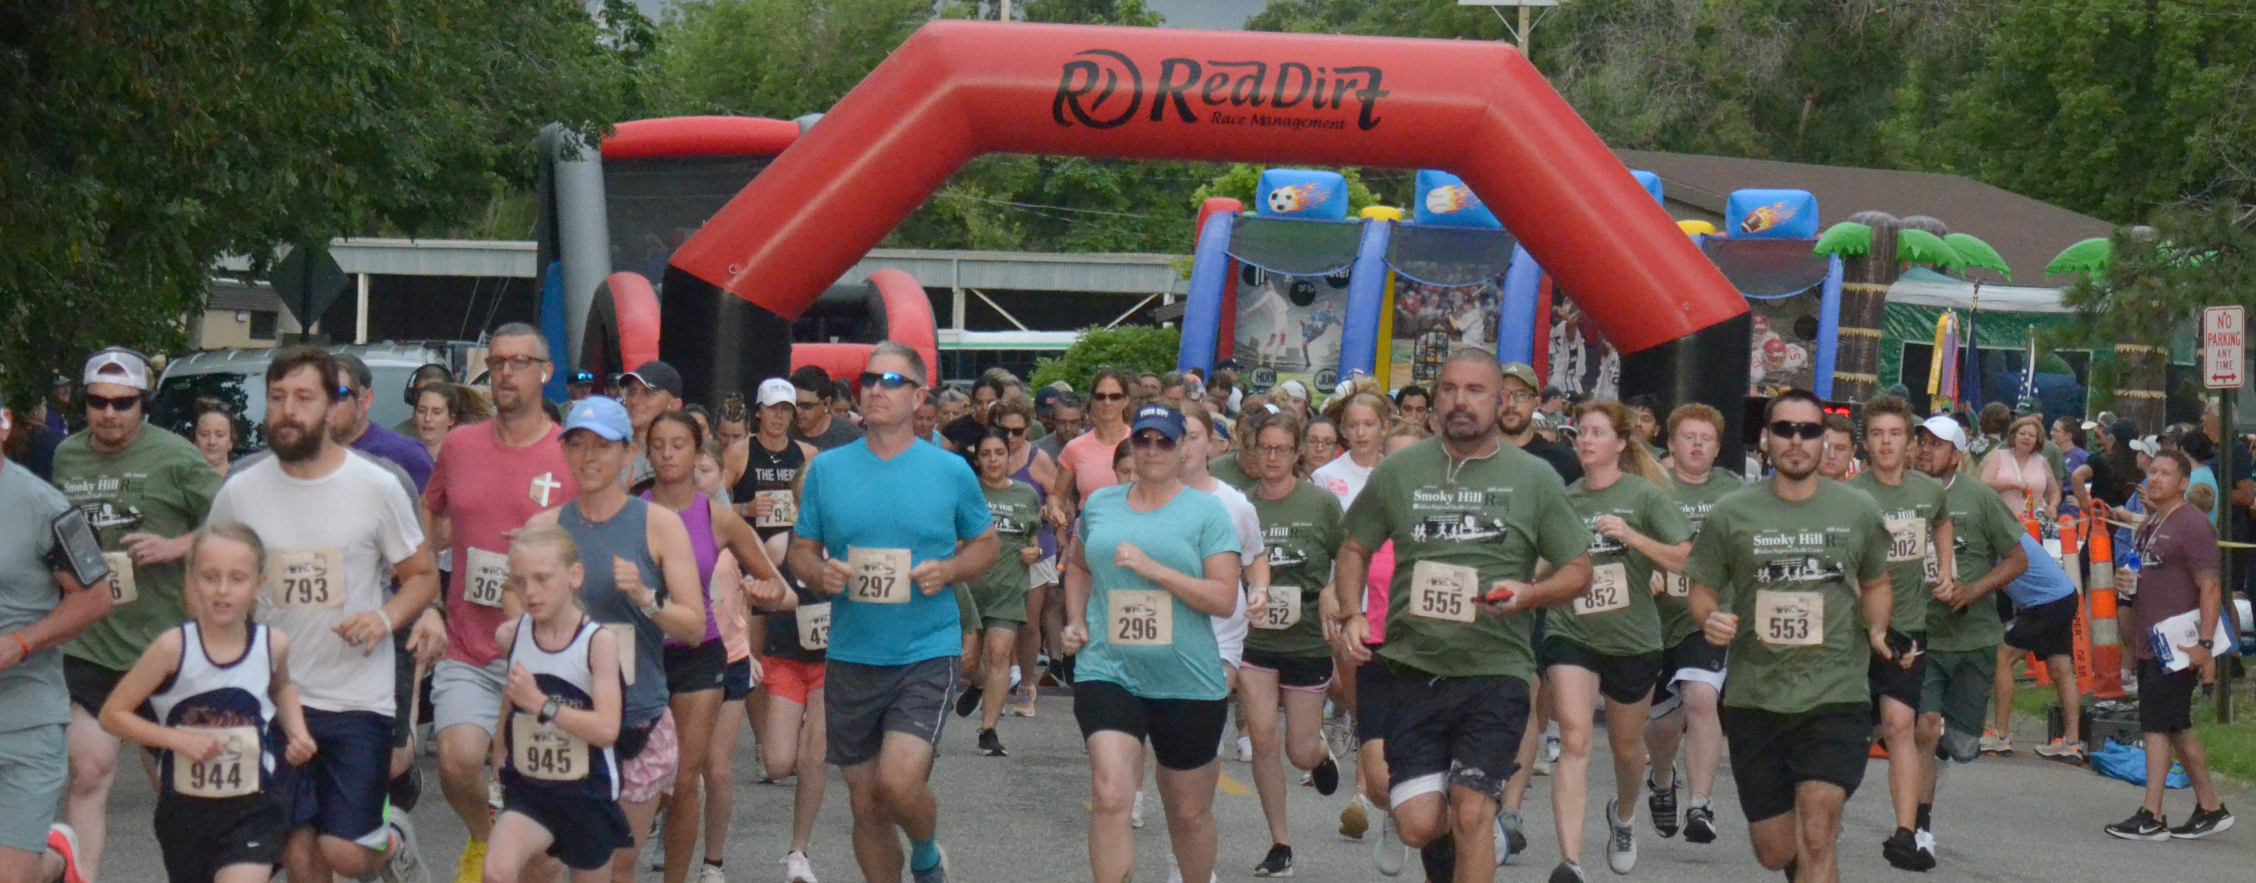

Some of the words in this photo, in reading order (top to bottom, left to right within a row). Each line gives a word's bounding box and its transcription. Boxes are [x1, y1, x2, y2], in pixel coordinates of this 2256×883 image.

[1211, 111, 1246, 125] Race
[1251, 114, 1346, 131] Management
[2217, 314, 2232, 329] NO
[2207, 332, 2241, 347] PARKING
[2216, 349, 2232, 358] ANY
[2215, 361, 2234, 370] TIME
[755, 468, 775, 481] THE
[776, 469, 797, 482] HER
[64, 481, 96, 495] Smoky
[97, 479, 120, 491] Hill
[1413, 490, 1454, 506] Smoky
[1457, 491, 1482, 503] Hill
[1898, 510, 1915, 520] Hill
[1269, 527, 1289, 537] Hill
[1753, 533, 1796, 549] Smoky
[1799, 533, 1823, 545] Hill
[283, 577, 329, 604] 793
[858, 575, 896, 598] 297
[1678, 577, 1688, 593] 9
[1422, 588, 1463, 615] 555
[1584, 586, 1618, 609] 852
[1268, 607, 1290, 625] 52
[1118, 617, 1157, 640] 296
[1769, 617, 1809, 640] 553
[527, 748, 572, 774] 945
[191, 762, 241, 791] 944
